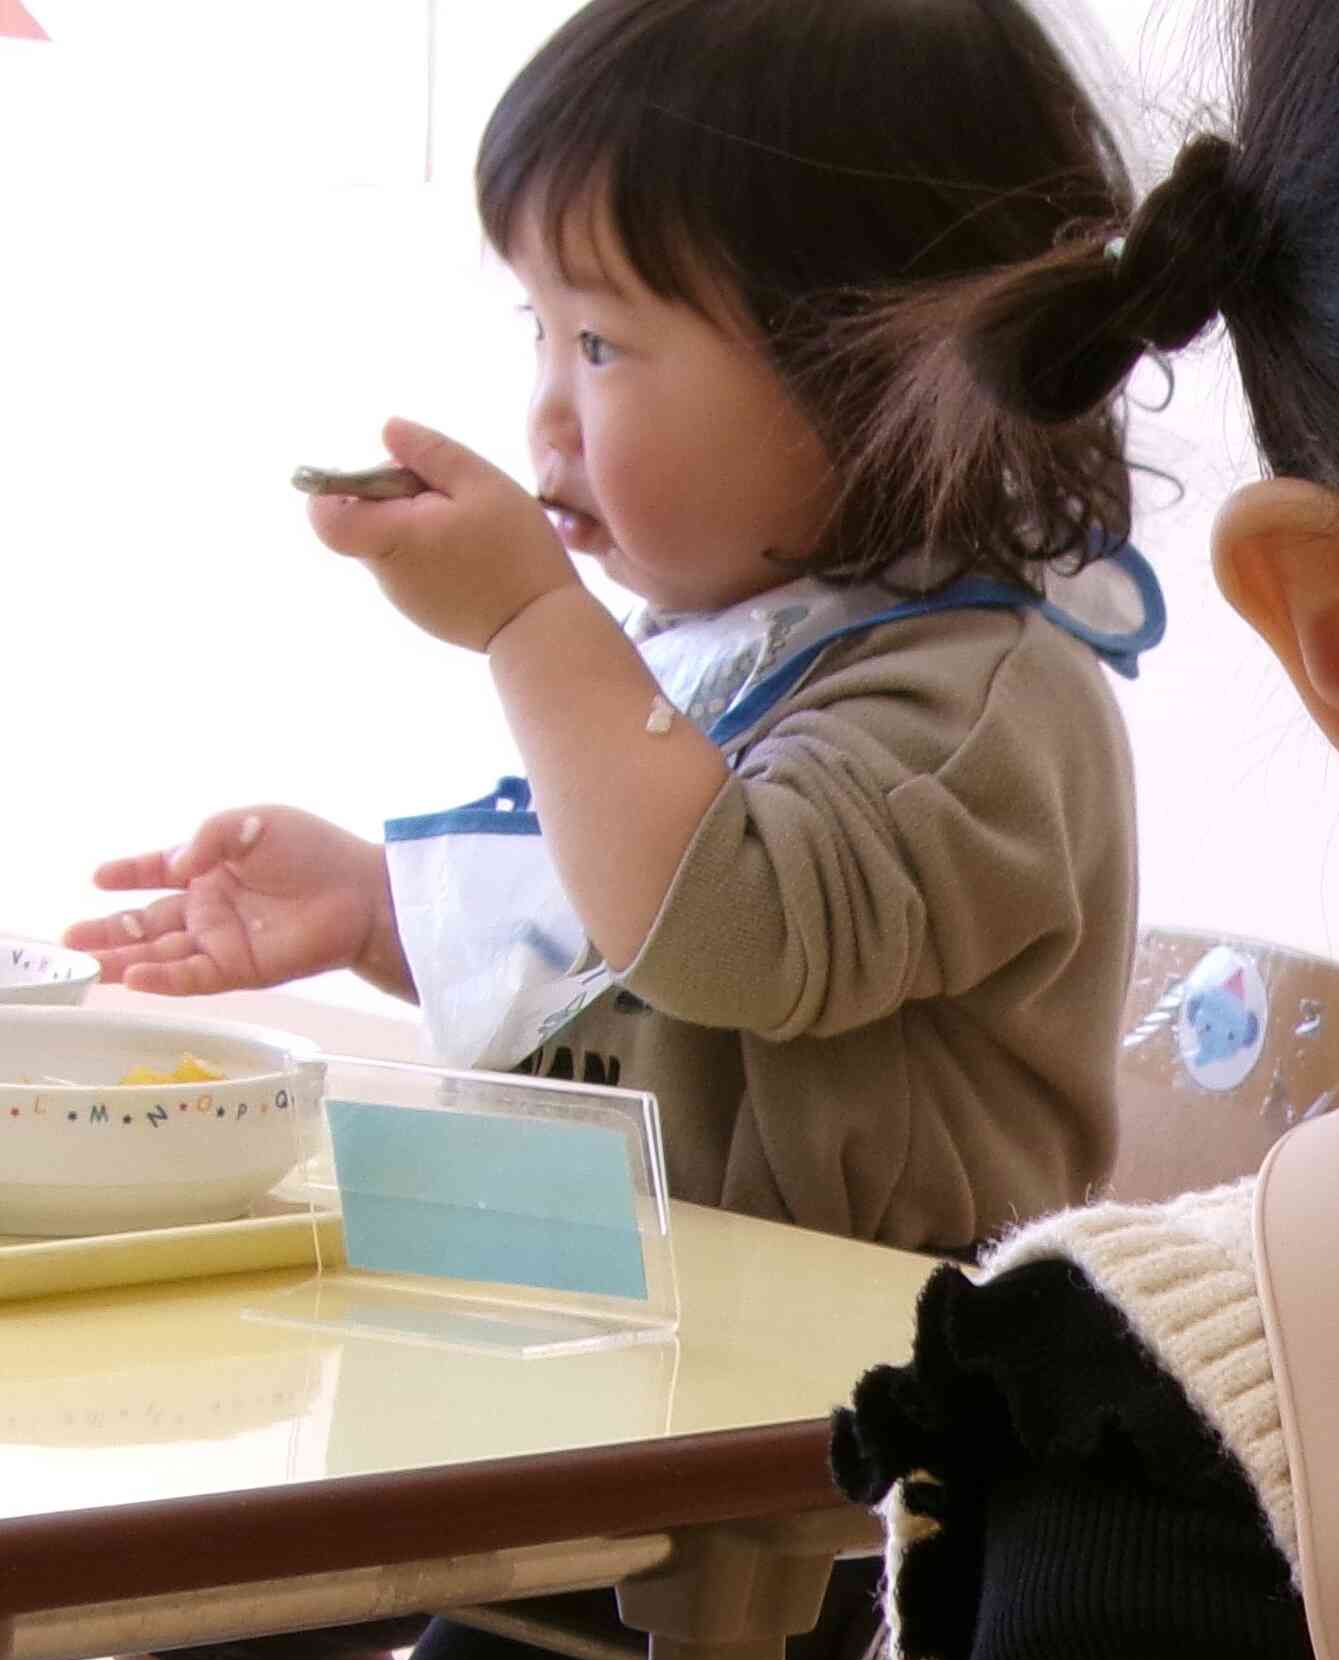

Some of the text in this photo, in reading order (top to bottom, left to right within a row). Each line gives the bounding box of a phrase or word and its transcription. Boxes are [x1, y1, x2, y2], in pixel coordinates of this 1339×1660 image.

[90, 1104, 109, 1123] M
[146, 1104, 168, 1128] N
[274, 1089, 289, 1109] Q
